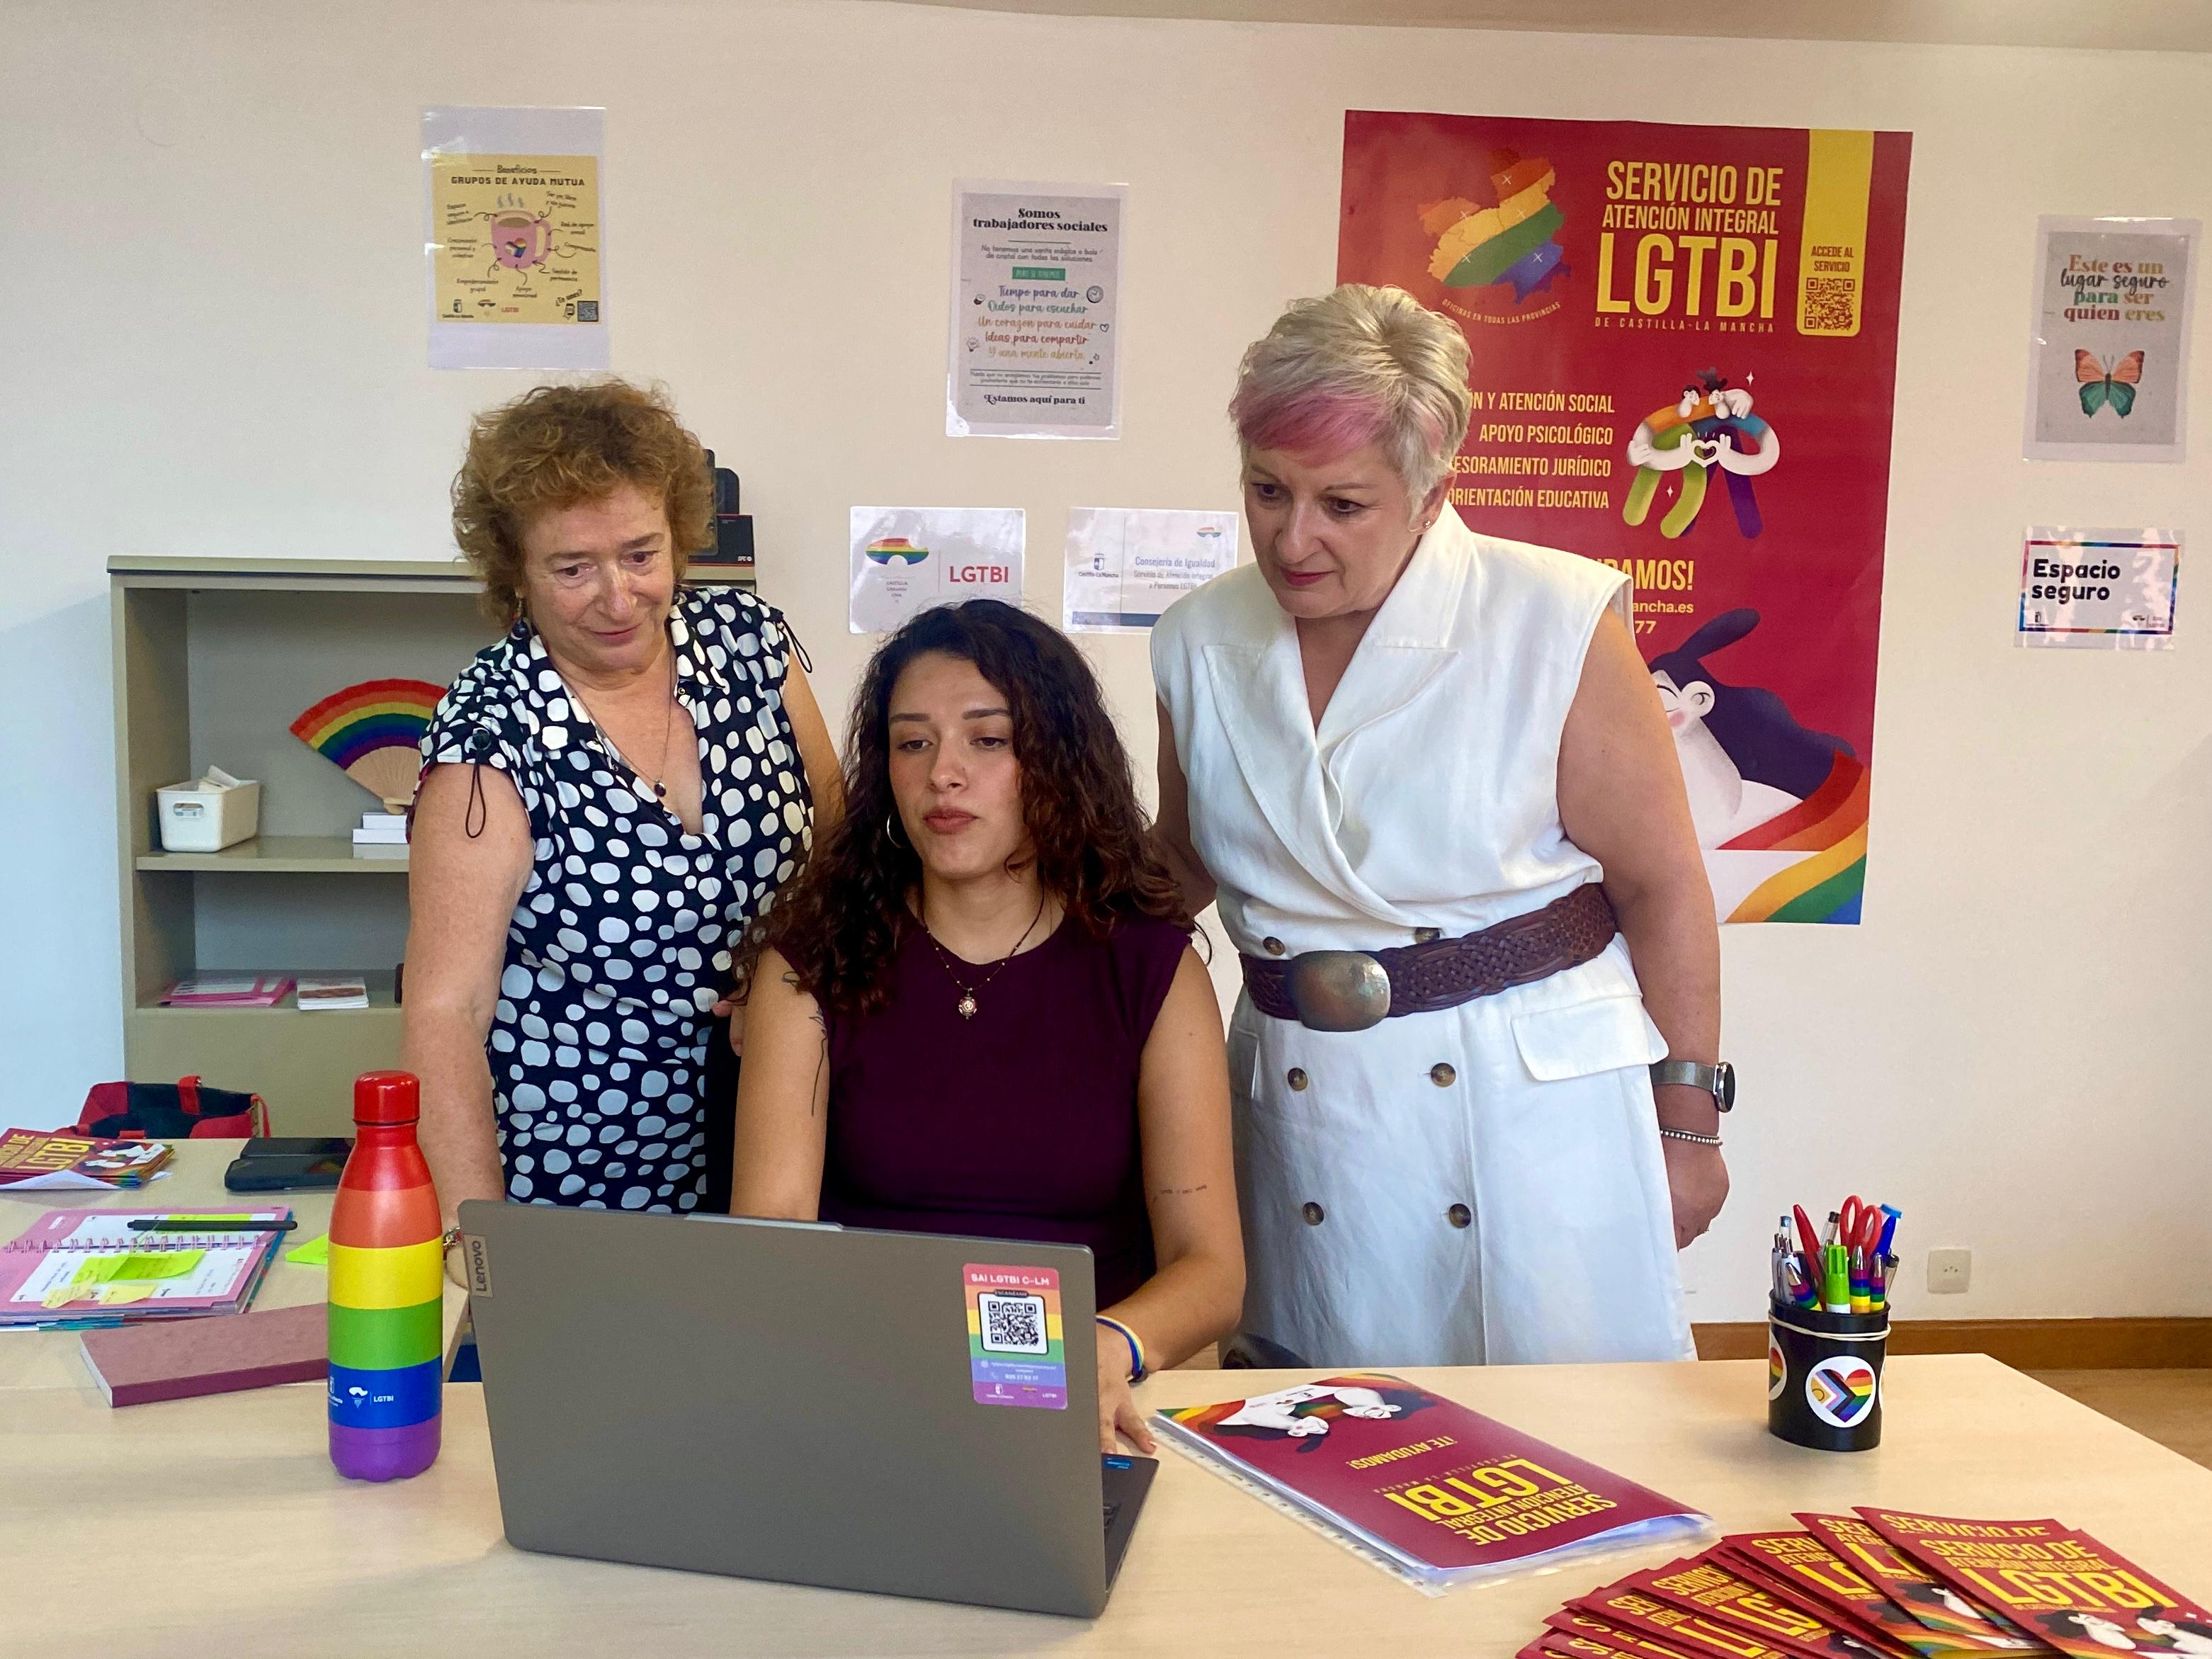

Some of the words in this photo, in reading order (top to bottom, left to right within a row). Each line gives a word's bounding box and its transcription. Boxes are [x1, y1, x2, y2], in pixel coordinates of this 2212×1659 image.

[511, 177, 546, 186] AYUDA
[1606, 161, 1737, 204] SERVICIO
[1745, 167, 1783, 205] DE
[1018, 208, 1060, 219] Somos
[1602, 202, 1689, 231] ATENCIÓN
[1694, 208, 1779, 234] INTEGRAL
[973, 218, 1054, 230] trabajadores
[1057, 220, 1108, 232] sociales
[1811, 246, 1843, 257] ACCEDE
[1844, 247, 1854, 258] AL
[1814, 260, 1850, 272] SERVICIO
[2068, 254, 2109, 273] Este
[2112, 261, 2133, 273] es
[2138, 262, 2164, 274] un
[1596, 232, 1779, 318] LGTBI
[2060, 268, 2109, 291] lugar
[2114, 275, 2170, 295] seguro
[1033, 288, 1057, 302] para
[1057, 287, 1080, 298] dar
[2074, 290, 2118, 305] para
[2123, 293, 2154, 305] ser
[1019, 303, 1043, 315] para
[2064, 305, 2120, 322] quien
[2125, 309, 2165, 321] eres
[1037, 321, 1062, 332] para
[1507, 316, 1519, 324] LAS
[1595, 317, 1609, 327] DE
[1720, 322, 1774, 333] MANCHA
[985, 331, 1010, 343] Ideas
[1013, 334, 1038, 346] para
[984, 394, 1028, 405] Estamos
[1030, 395, 1052, 404] aquí
[1078, 396, 1085, 404] ti
[1487, 392, 1496, 409] Y
[1499, 390, 1565, 411] ATENCIÓN
[1569, 394, 1615, 413] SOCIAL
[1479, 424, 1523, 443] APOYO
[1527, 423, 1613, 445] PSICOLÓGICO
[1452, 455, 1548, 475] ESORAMIENTO
[1552, 455, 1611, 477] JURÍDICO
[1538, 489, 1609, 509] EDUCATIVA
[1174, 557, 1183, 567] de
[1185, 557, 1215, 569] Igualdad
[2033, 558, 2121, 583] Espacio
[950, 566, 1009, 582] LGTBI
[1598, 558, 1694, 591] AMOS!
[2031, 584, 2110, 605] seguro
[1635, 621, 1656, 634] 77
[15, 1138, 96, 1171] LGTBI
[472, 1240, 487, 1292] Lenovo
[990, 1274, 1020, 1284] LGTBI
[1022, 1276, 1050, 1286] C-LM
[1347, 1442, 1432, 1470] AYUDAMOS!
[1384, 1458, 1574, 1522] LGTBI
[1513, 1483, 1590, 1509] ATENCIÓN
[1436, 1503, 1520, 1529] INTEGRAL
[1495, 1493, 1618, 1536] SERVICIO
[1454, 1525, 1507, 1546] DE
[1919, 1539, 2054, 1561] SERVICIO
[2046, 1539, 2097, 1558] DE
[2033, 1558, 2120, 1573] INTEGRAL
[1958, 1568, 2179, 1608] LGTBI
